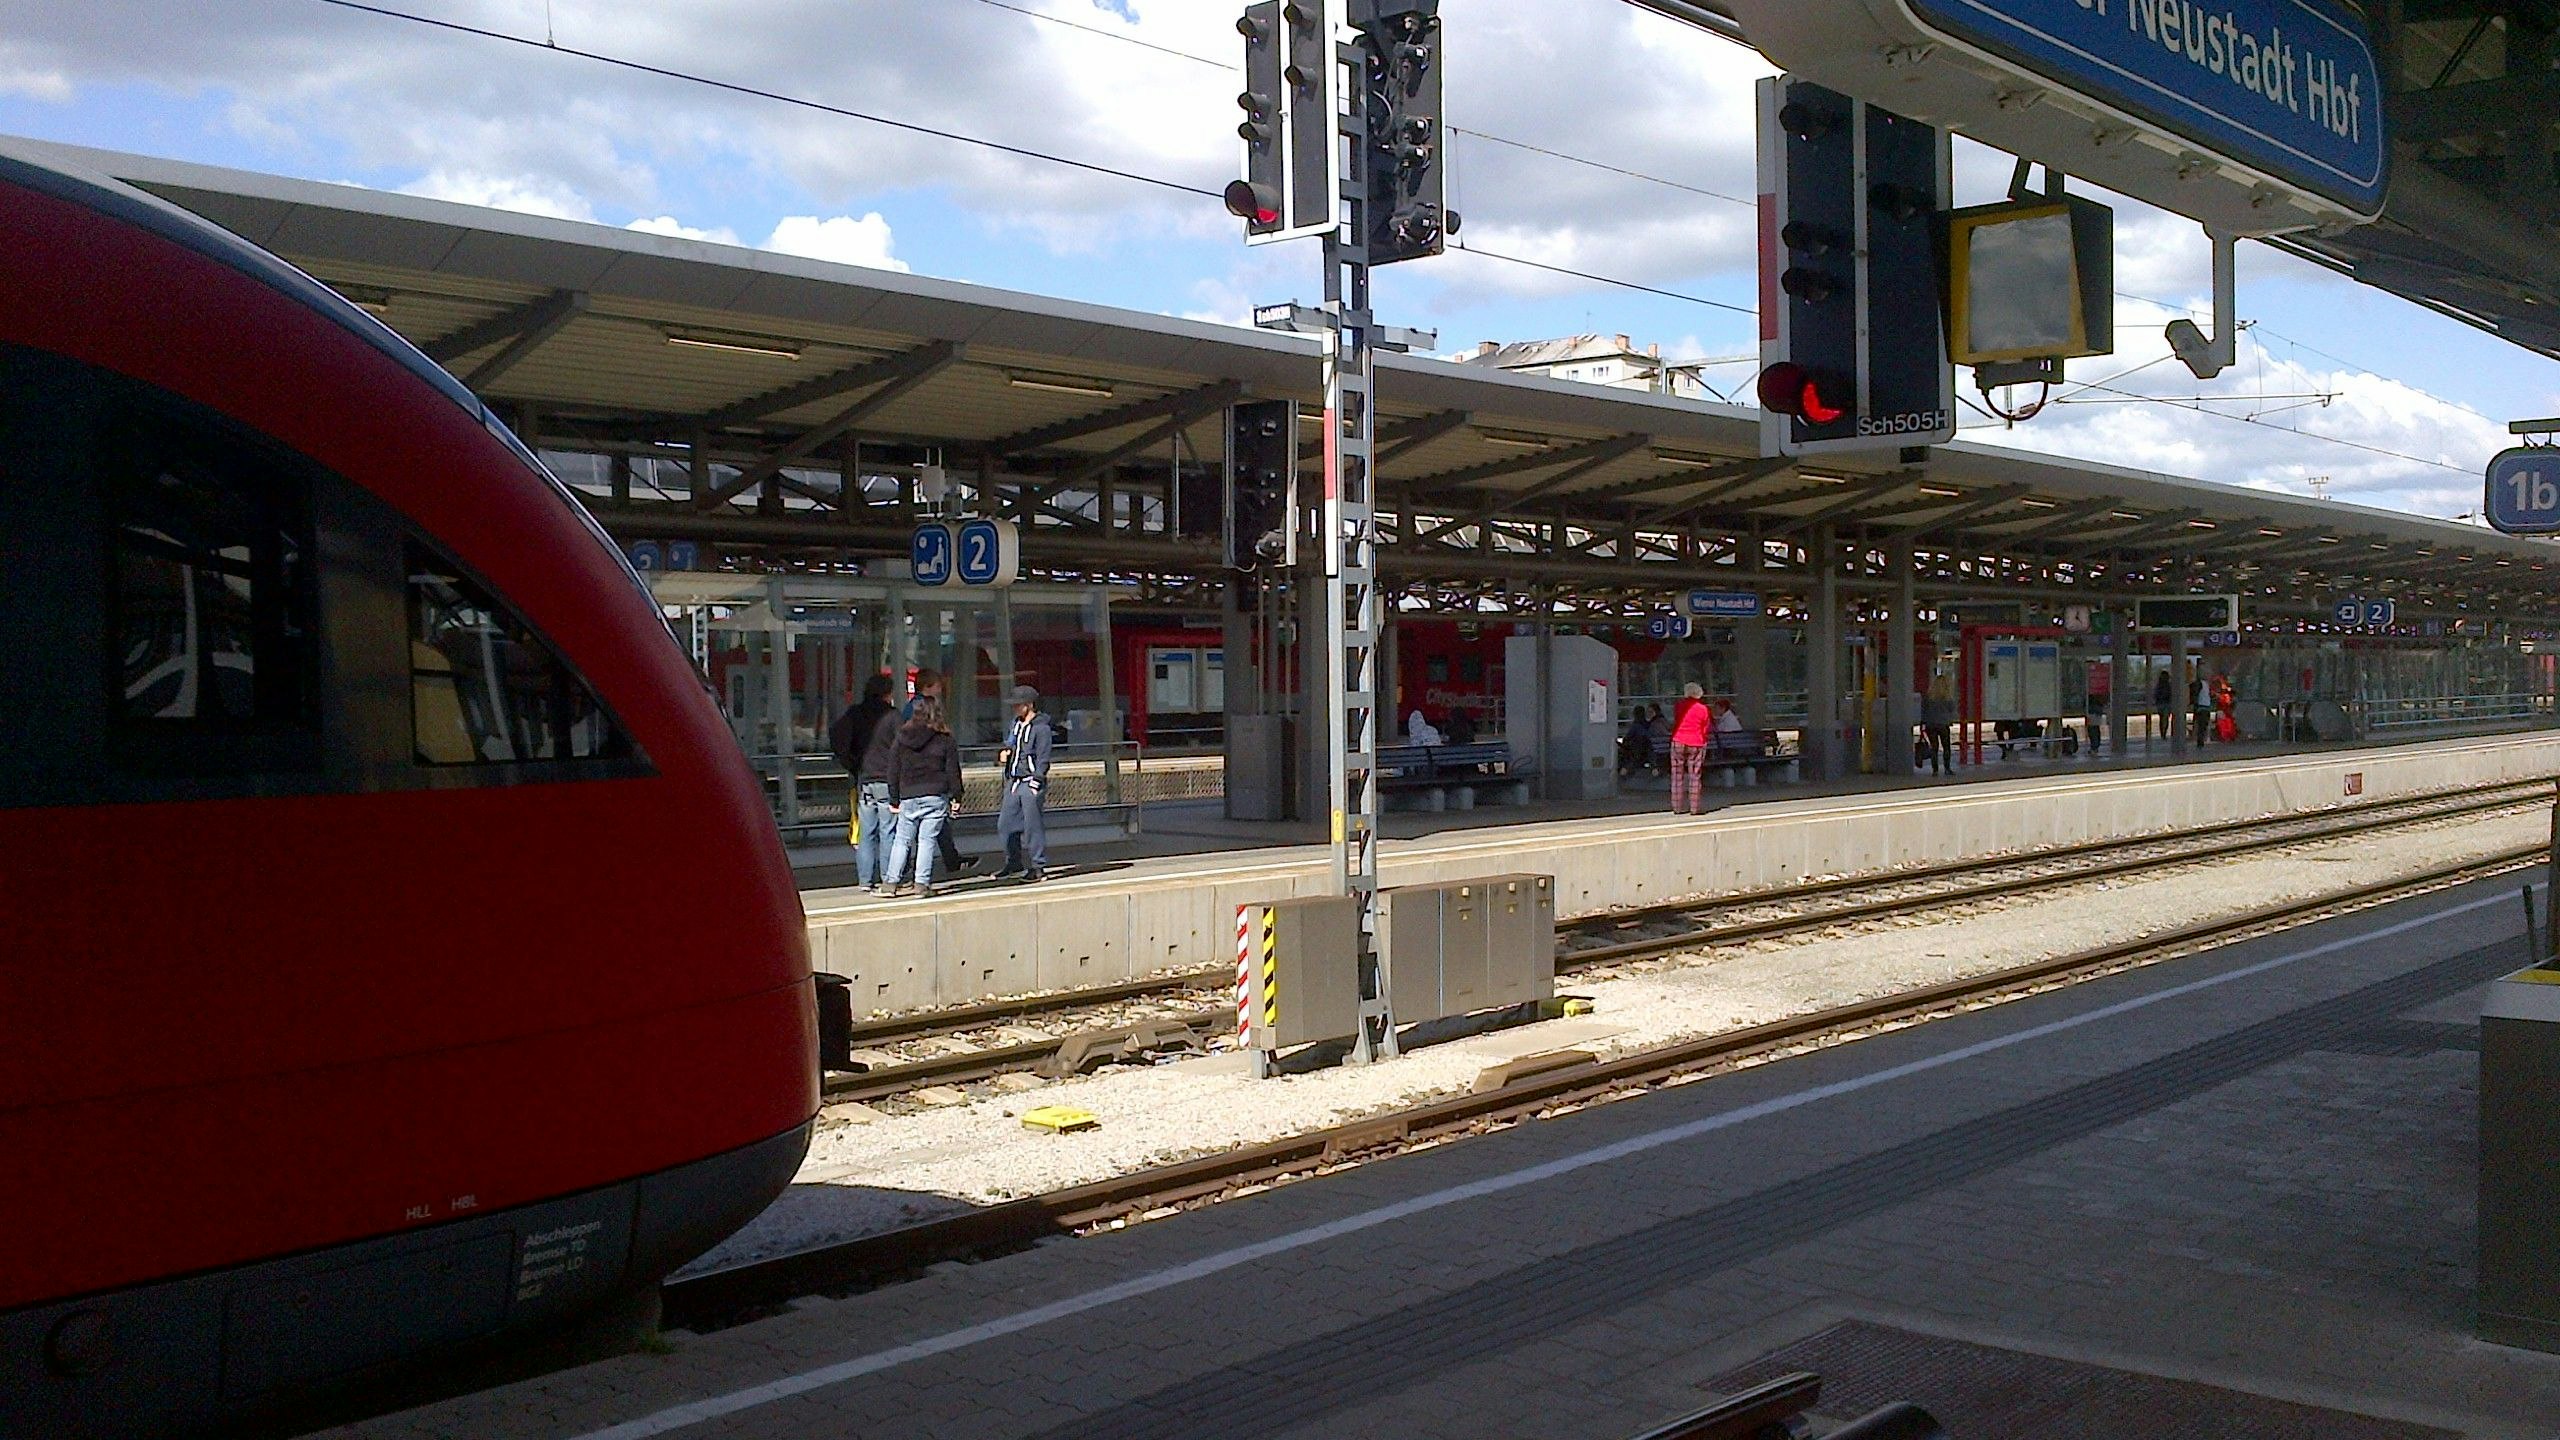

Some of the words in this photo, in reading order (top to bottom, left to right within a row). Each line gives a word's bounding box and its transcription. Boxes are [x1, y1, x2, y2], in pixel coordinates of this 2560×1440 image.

[2305, 51, 2361, 144] Hbf
[1858, 409, 1950, 435] Sch505H
[2507, 471, 2557, 511] 1b
[970, 534, 988, 571] 2
[1673, 620, 1682, 631] 4
[2371, 604, 2384, 620] 2
